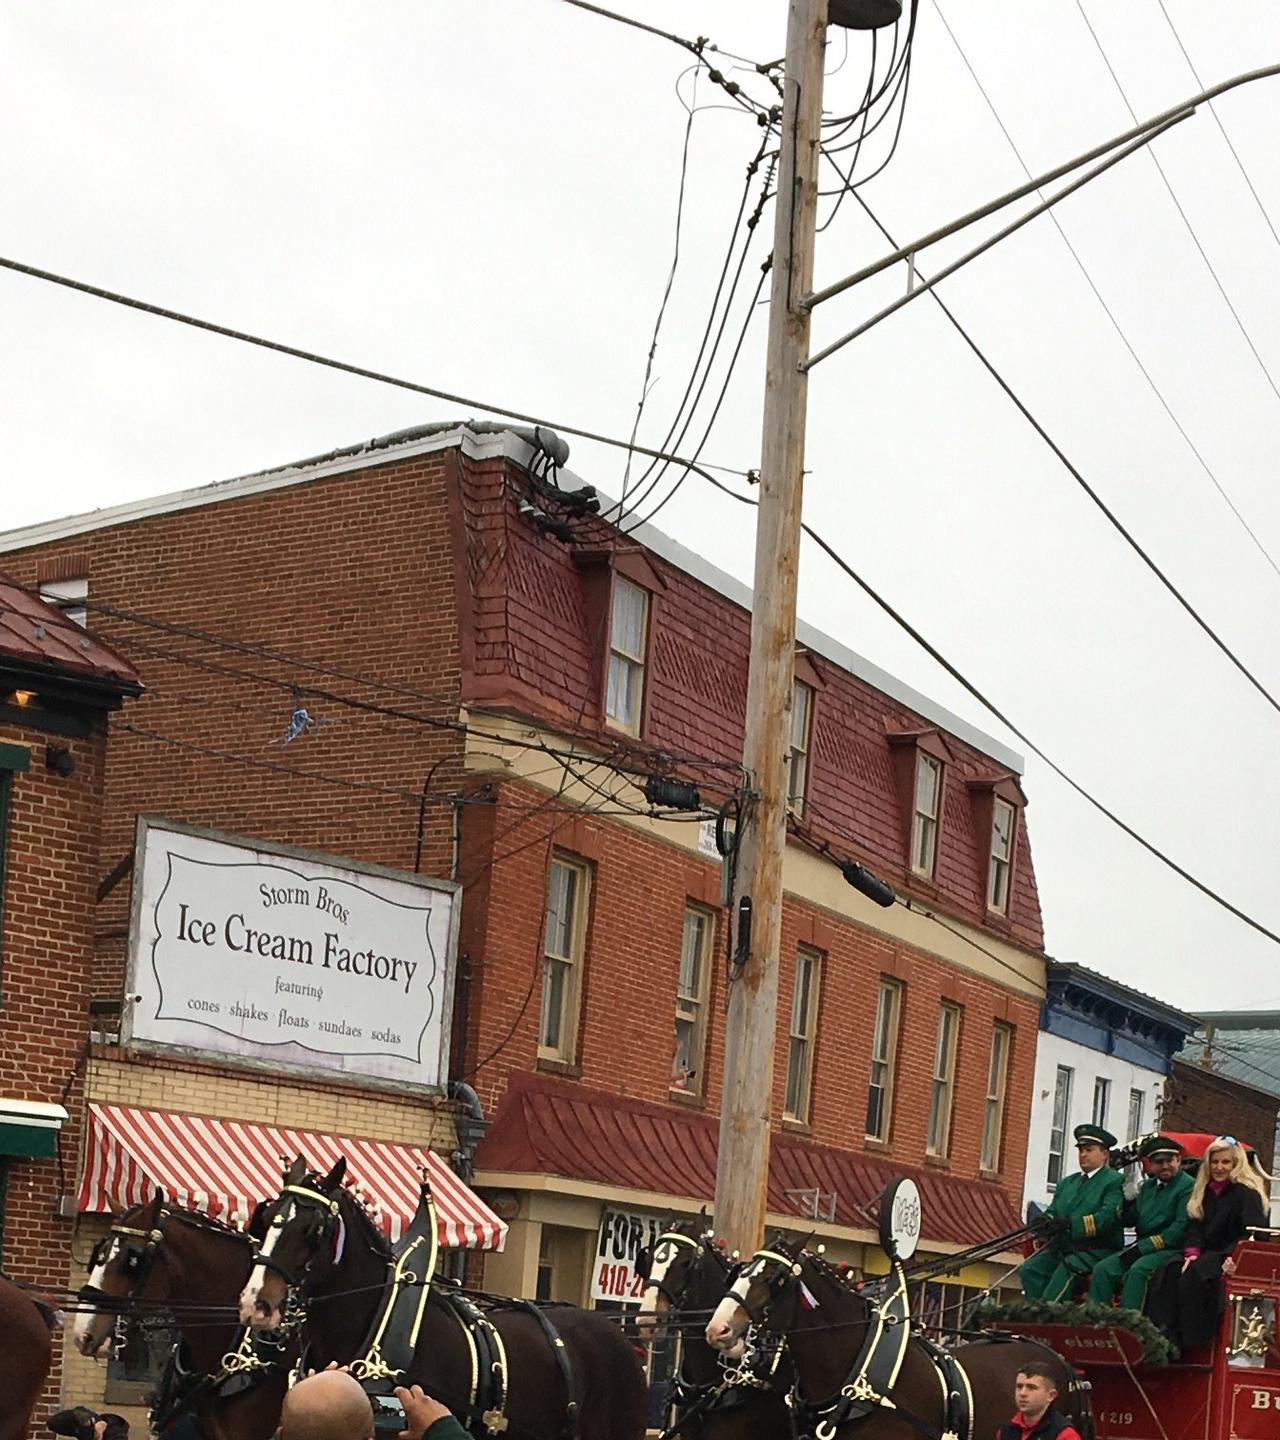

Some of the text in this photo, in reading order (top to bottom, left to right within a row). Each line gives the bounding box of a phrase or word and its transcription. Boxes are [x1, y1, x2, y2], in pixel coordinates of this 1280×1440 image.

[259, 883, 350, 926] Storm Bros.
[177, 903, 418, 994] Ice Cream Factory
[274, 975, 324, 1002] featuring
[187, 997, 402, 1045] cones shakes floats sundaes sodas
[599, 1211, 643, 1261] FOR
